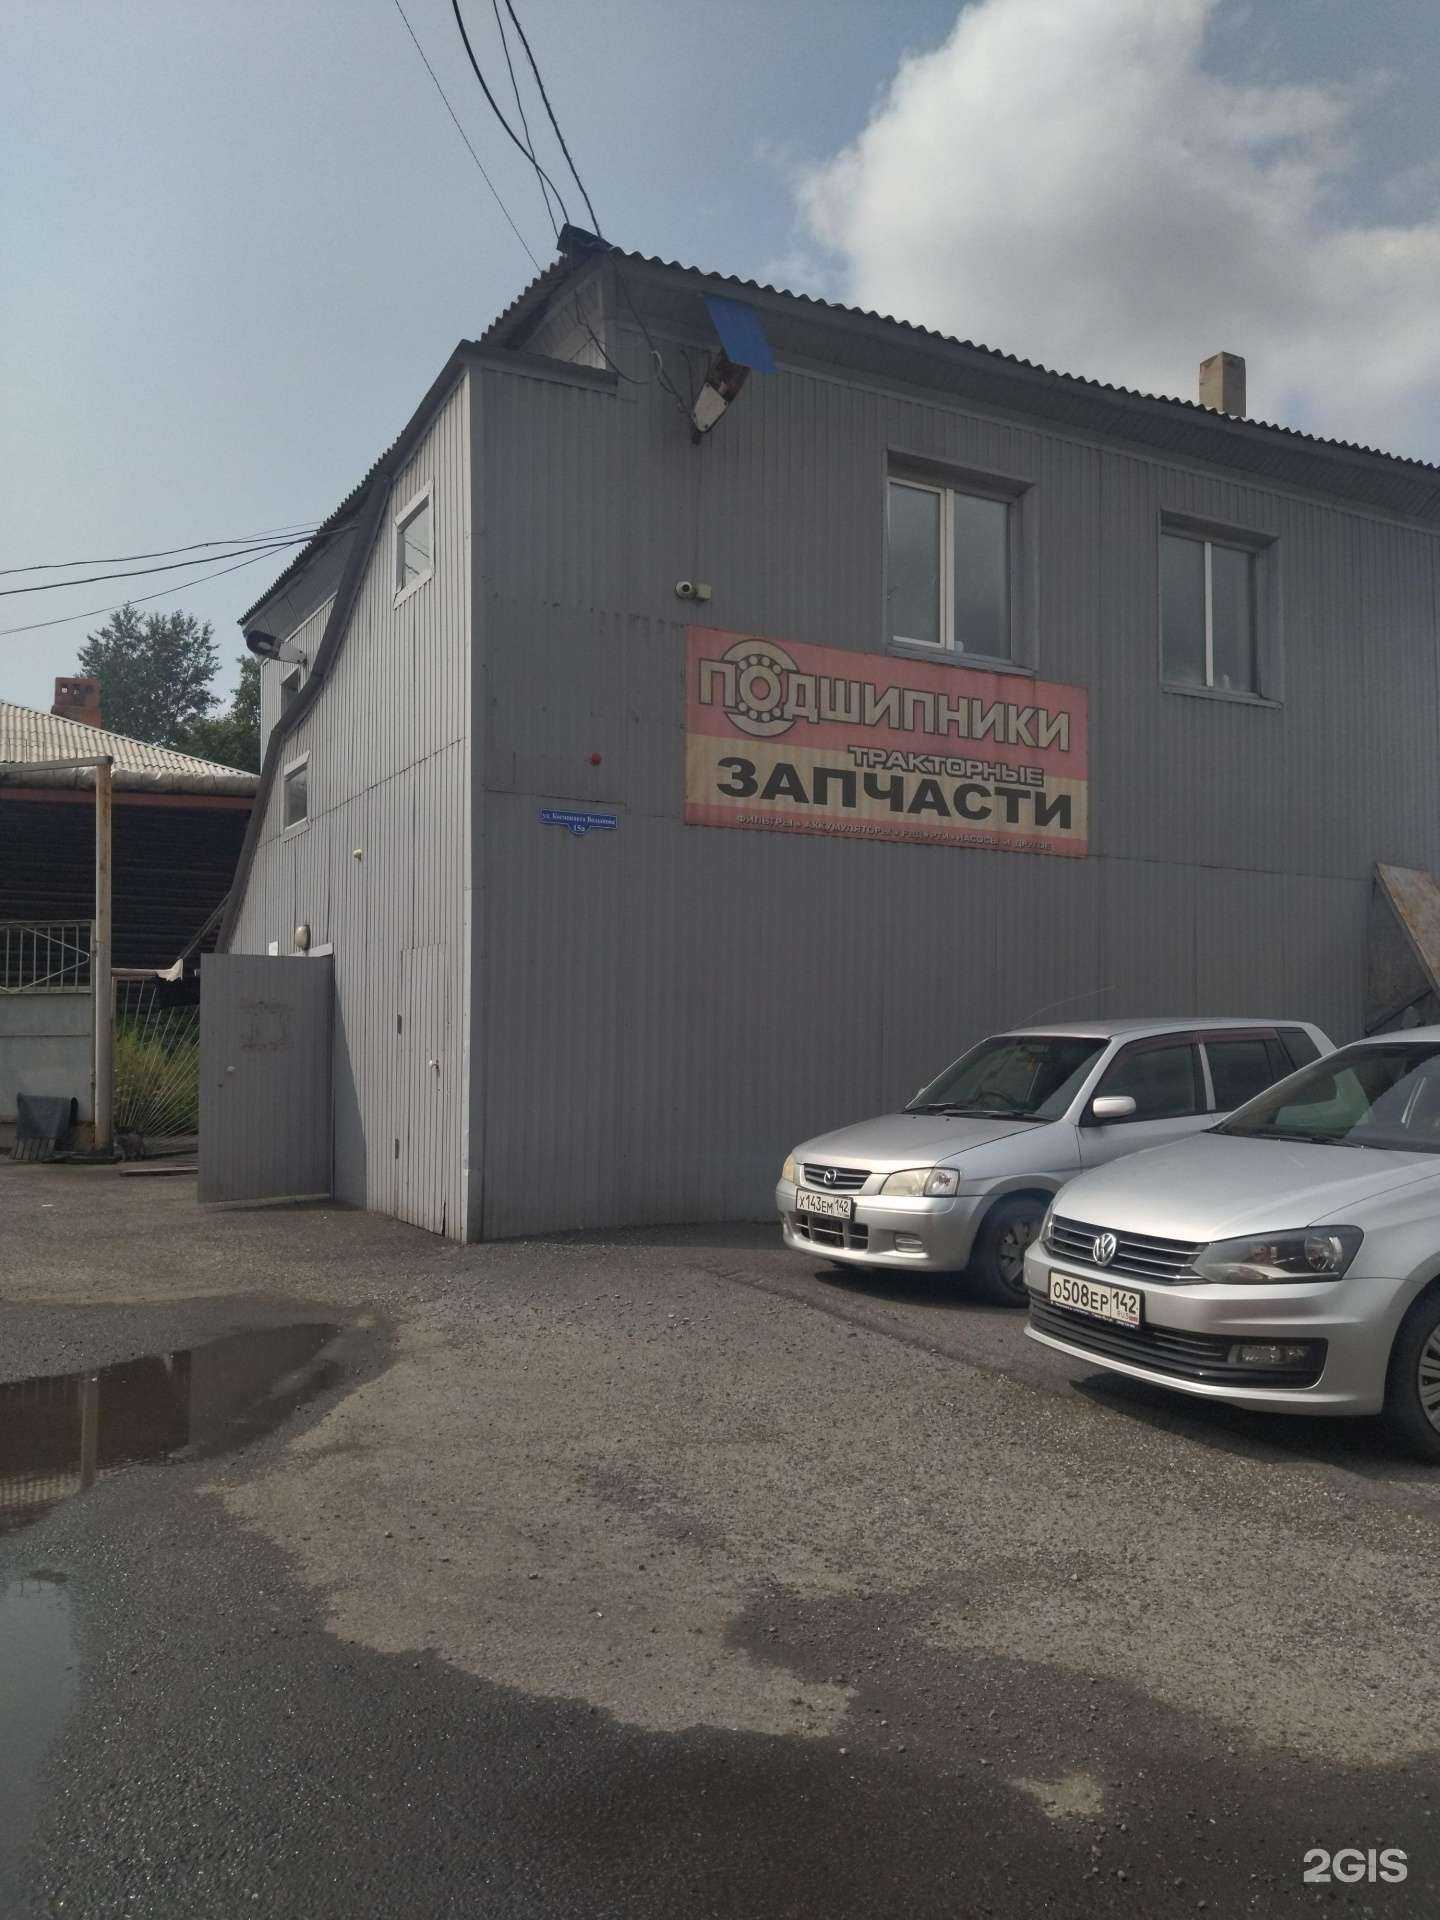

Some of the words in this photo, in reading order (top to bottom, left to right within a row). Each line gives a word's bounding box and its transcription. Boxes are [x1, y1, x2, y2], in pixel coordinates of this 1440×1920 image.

[699, 650, 1072, 753] ПОДШИПНИКИ
[716, 756, 1073, 830] ЗАПЧАСТИ
[848, 744, 1045, 787] ТРАКТОРНЫЕ
